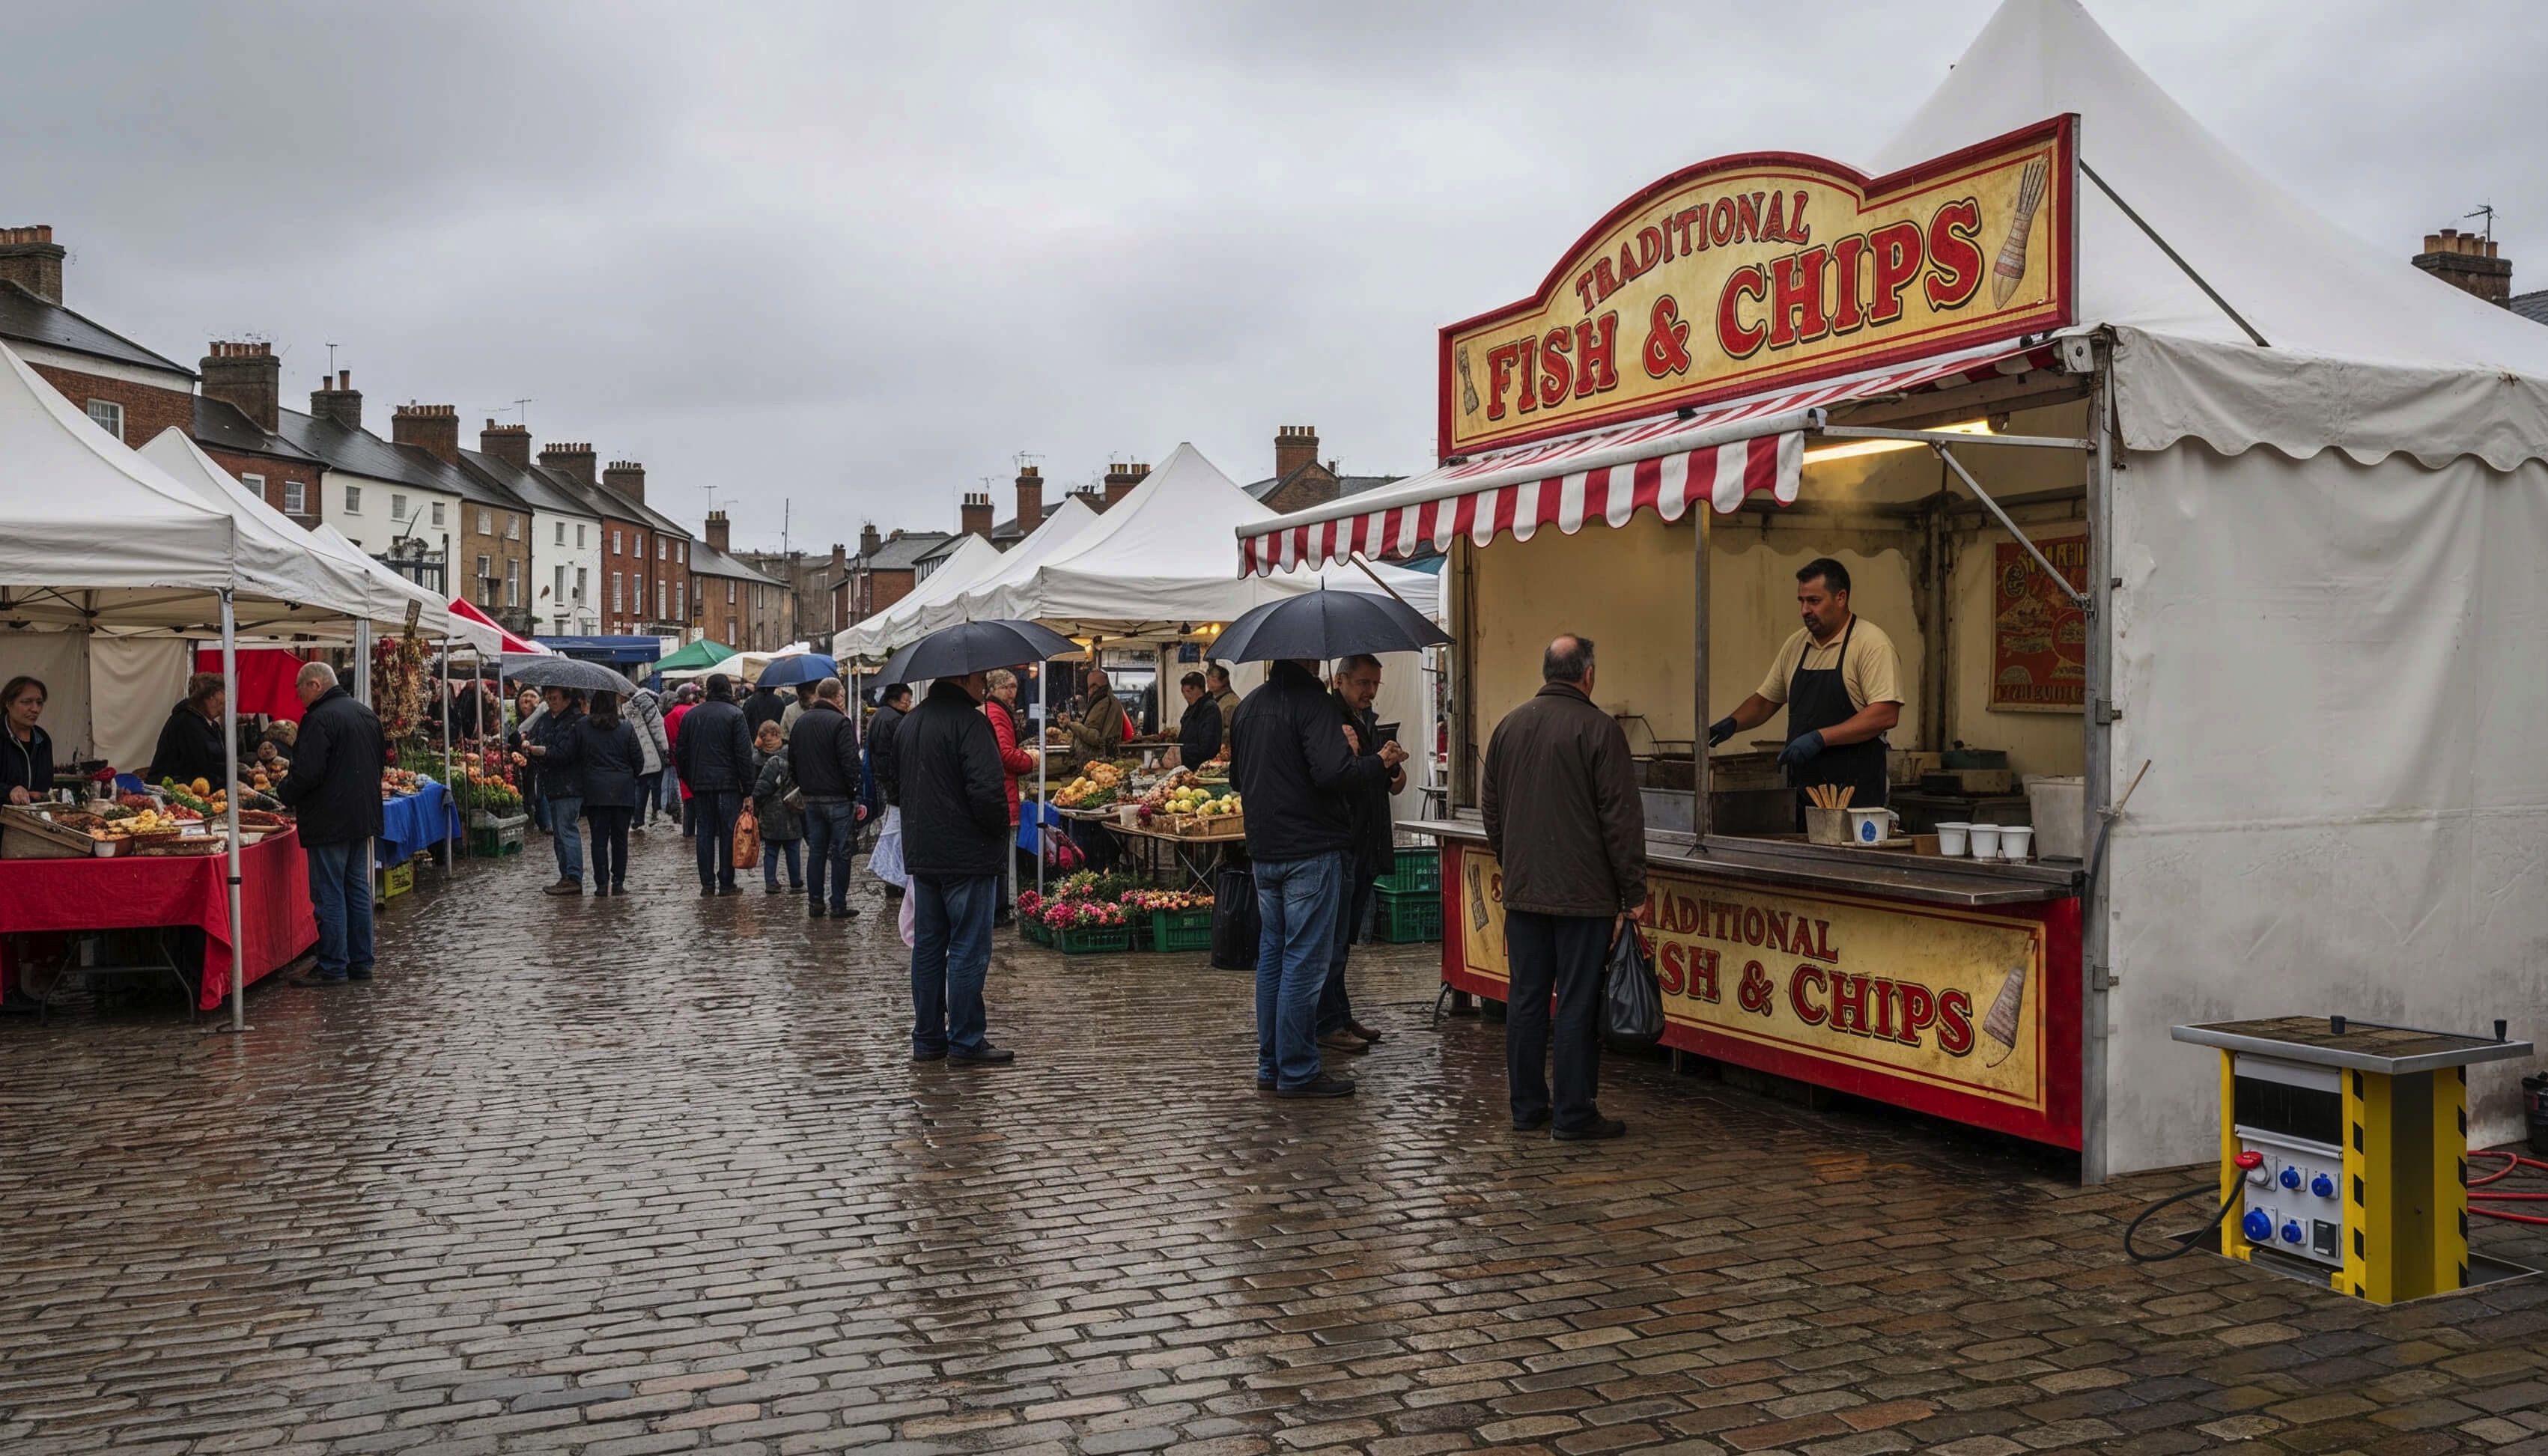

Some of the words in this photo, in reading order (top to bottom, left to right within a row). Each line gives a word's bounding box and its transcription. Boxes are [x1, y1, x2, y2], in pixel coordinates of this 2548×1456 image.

[1486, 309, 1619, 421] FISH
[1643, 294, 1691, 380] &
[1716, 198, 1985, 360] CHIPS
[1575, 190, 1810, 314] TRADITIONAL
[1638, 889, 1839, 964] ADITIONAL
[1657, 940, 1721, 1004] SH
[1737, 960, 1774, 1017] &
[1789, 963, 1975, 1057] CHIPS
